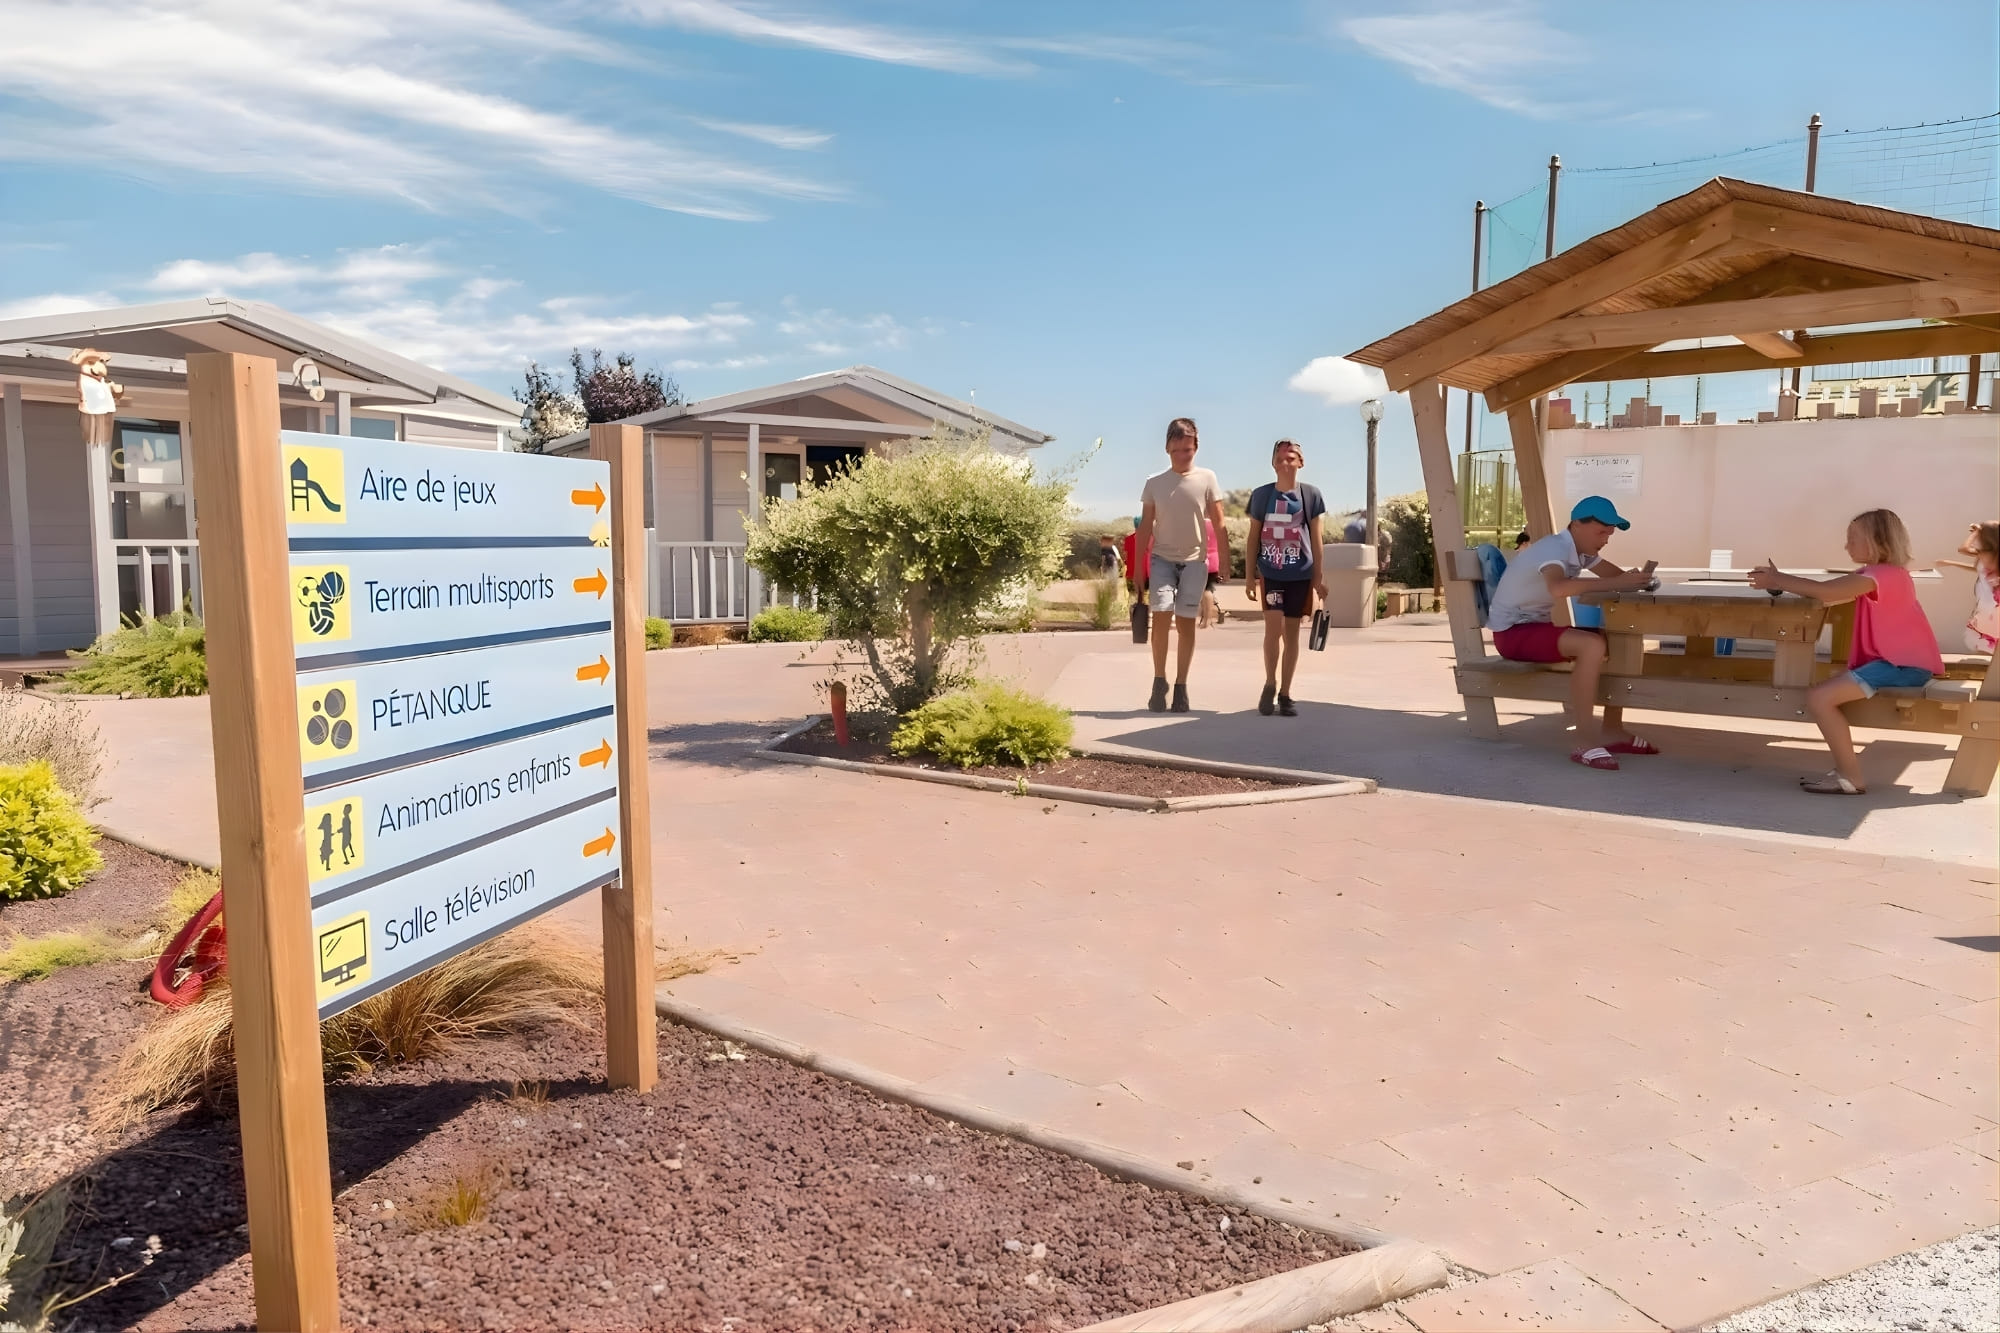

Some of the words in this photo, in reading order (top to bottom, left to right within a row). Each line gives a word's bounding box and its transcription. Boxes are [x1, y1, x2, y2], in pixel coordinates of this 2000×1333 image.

[360, 467, 407, 501] Aire
[416, 470, 445, 503] de
[453, 475, 497, 511] jeux
[364, 579, 440, 613] Terrain
[449, 573, 554, 609] multisports
[372, 680, 492, 731] PÉTANQUE
[378, 777, 501, 837] Animations
[508, 755, 571, 794] enfants
[384, 906, 438, 951] Salle
[444, 868, 535, 925] télévision
